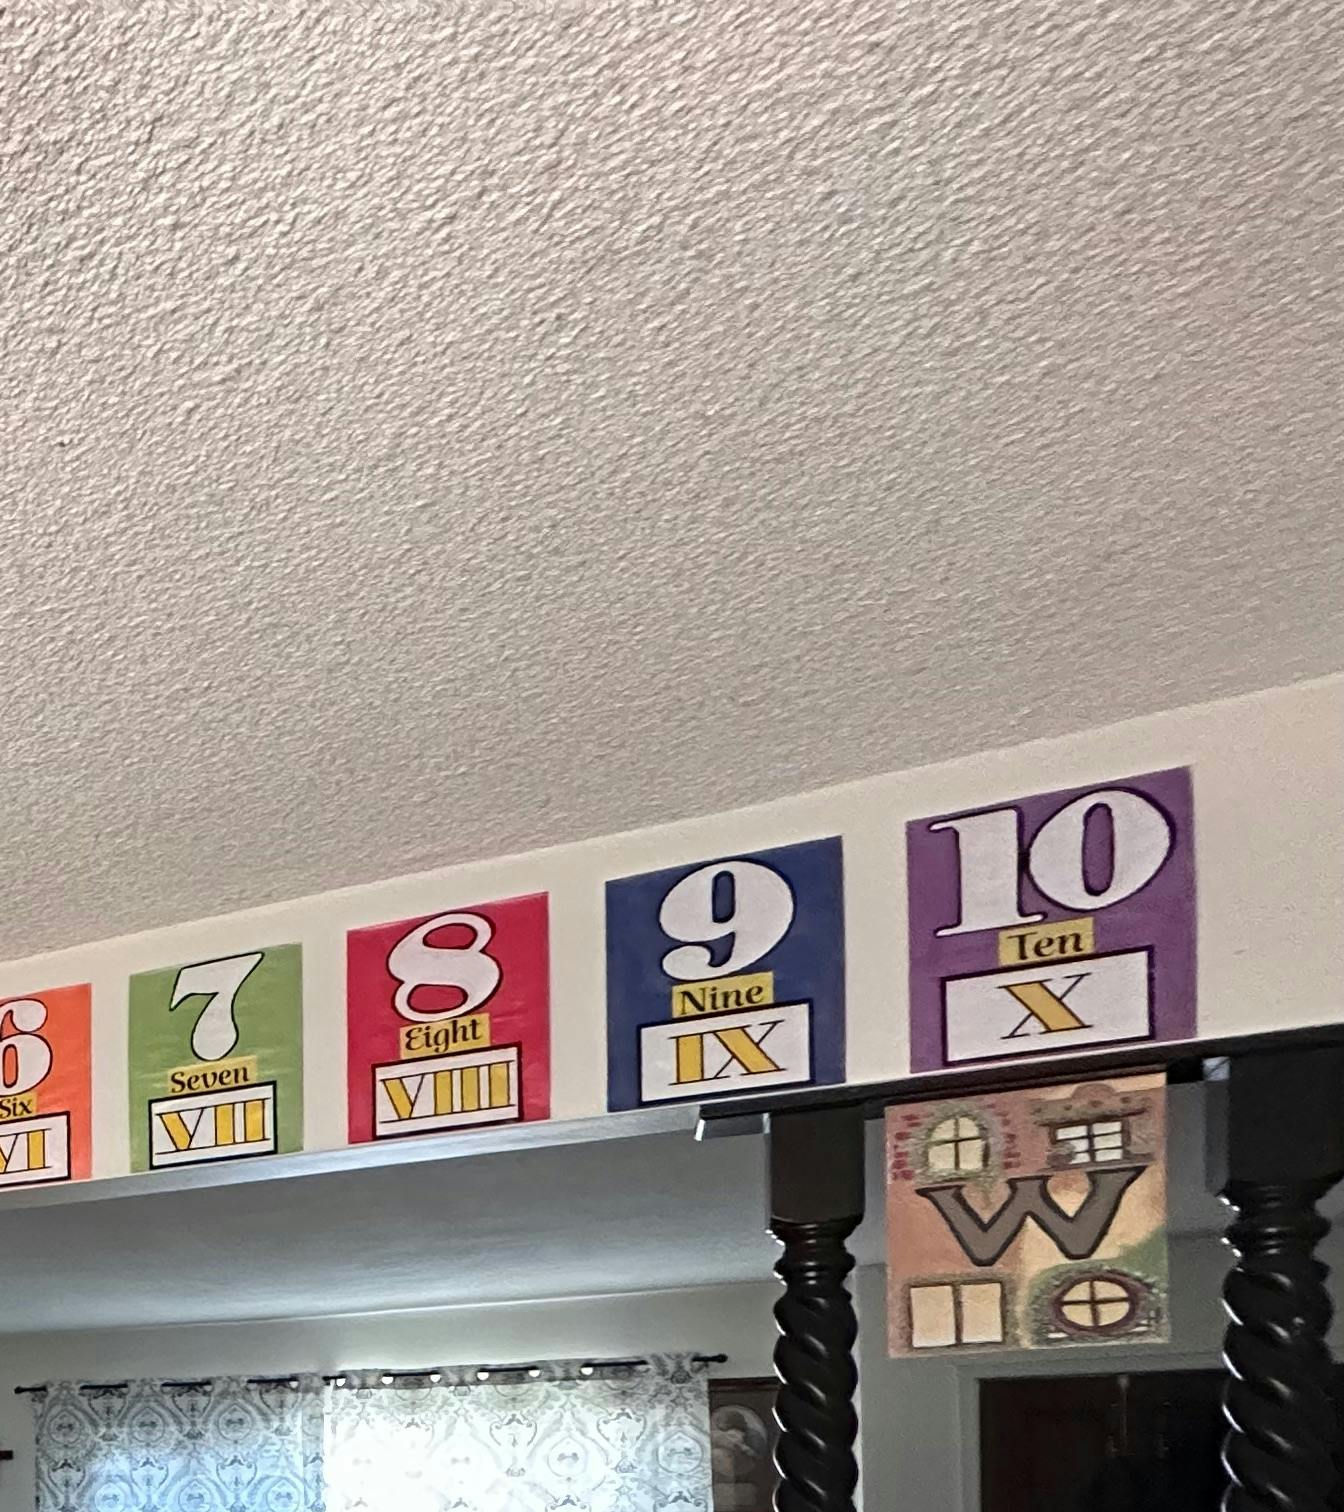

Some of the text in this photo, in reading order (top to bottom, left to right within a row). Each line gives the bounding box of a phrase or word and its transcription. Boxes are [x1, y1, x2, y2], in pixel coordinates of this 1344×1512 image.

[928, 786, 1175, 937] 10
[659, 859, 796, 981] 9
[1009, 928, 1083, 961] Ten
[386, 911, 502, 1023] 8
[679, 981, 764, 1015] Nine
[170, 952, 264, 1061] 7
[406, 1019, 483, 1054] Eight
[998, 973, 1092, 1039] X
[171, 1066, 249, 1093] Seven
[668, 1020, 786, 1086] IX
[379, 1060, 516, 1123] VIII
[155, 1098, 272, 1154] VII
[915, 1165, 1149, 1266] W
